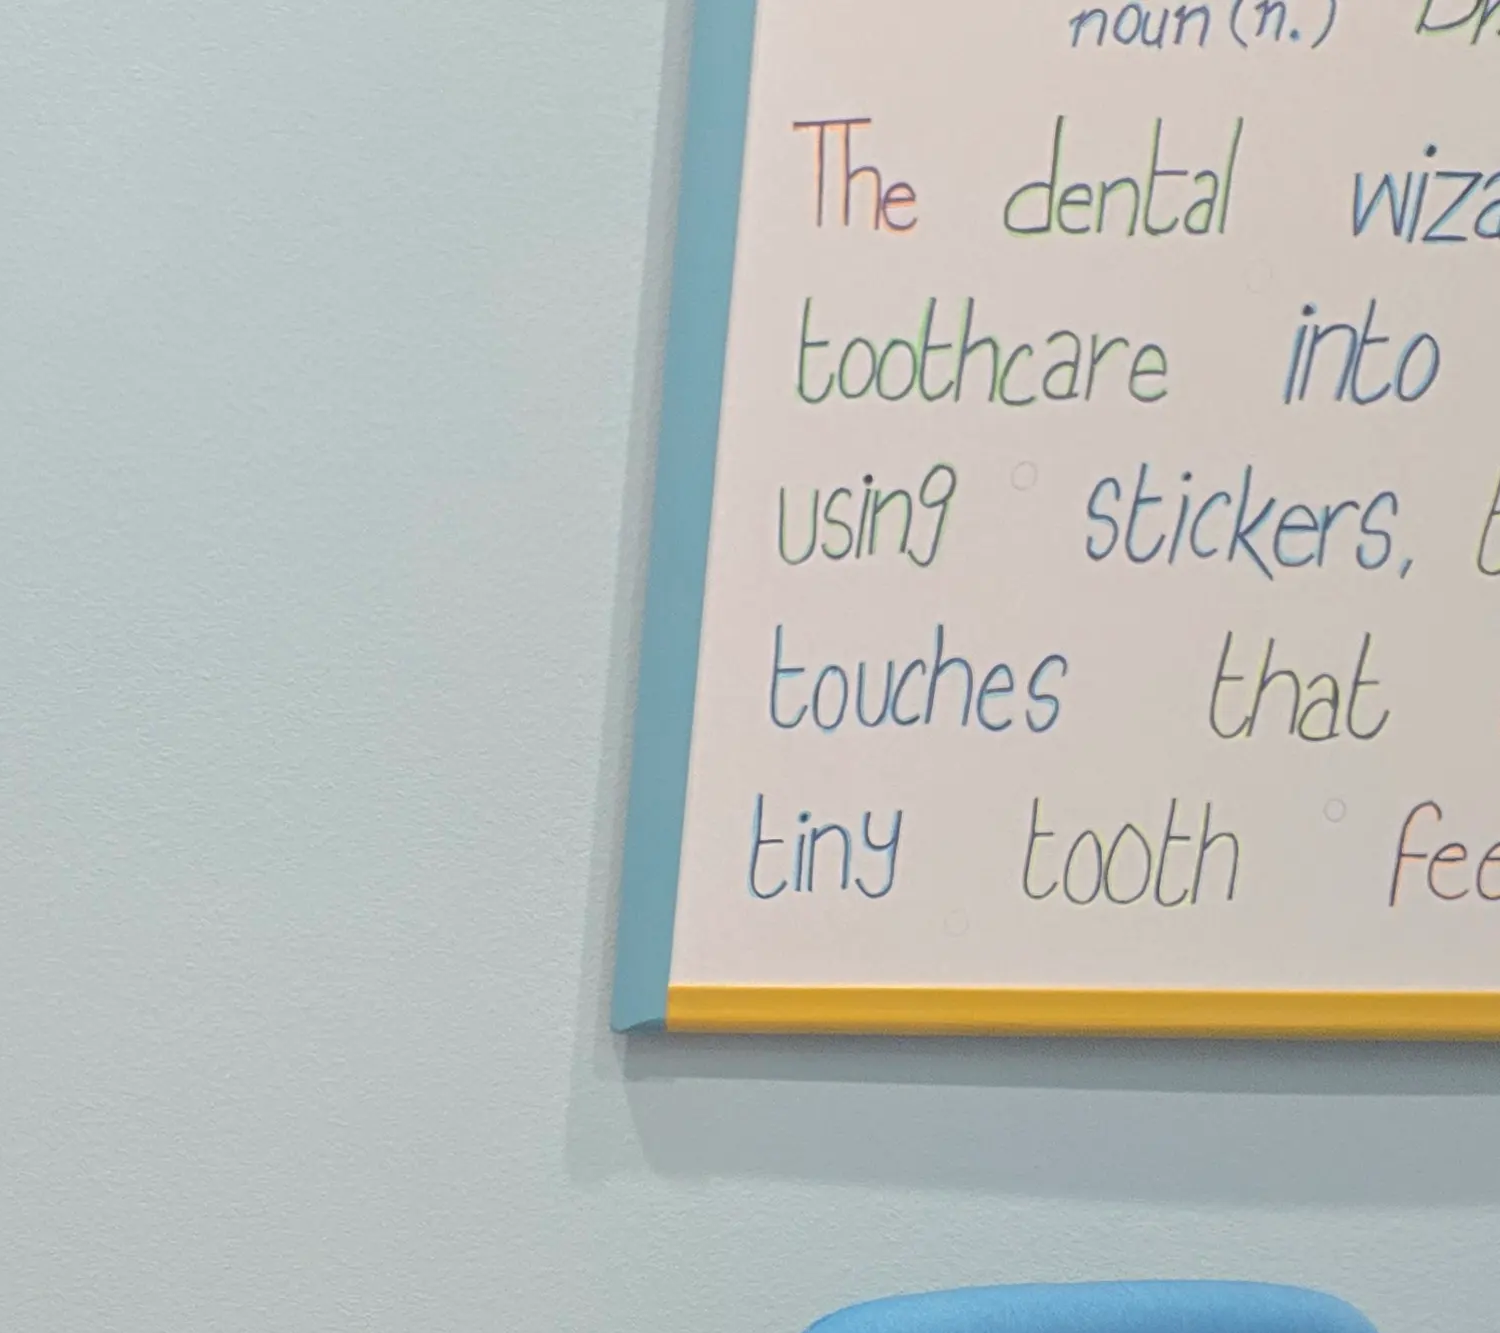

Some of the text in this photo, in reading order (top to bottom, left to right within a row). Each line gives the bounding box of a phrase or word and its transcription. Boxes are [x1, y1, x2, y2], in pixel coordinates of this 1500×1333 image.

[792, 117, 919, 232] The
[1003, 115, 1244, 237] dental
[796, 296, 1441, 406] toothcare into
[778, 463, 958, 568] using
[1084, 462, 1414, 580] stickers,
[768, 624, 1391, 742] touches that
[746, 793, 903, 900] tiny
[1021, 797, 1241, 908] tooth
